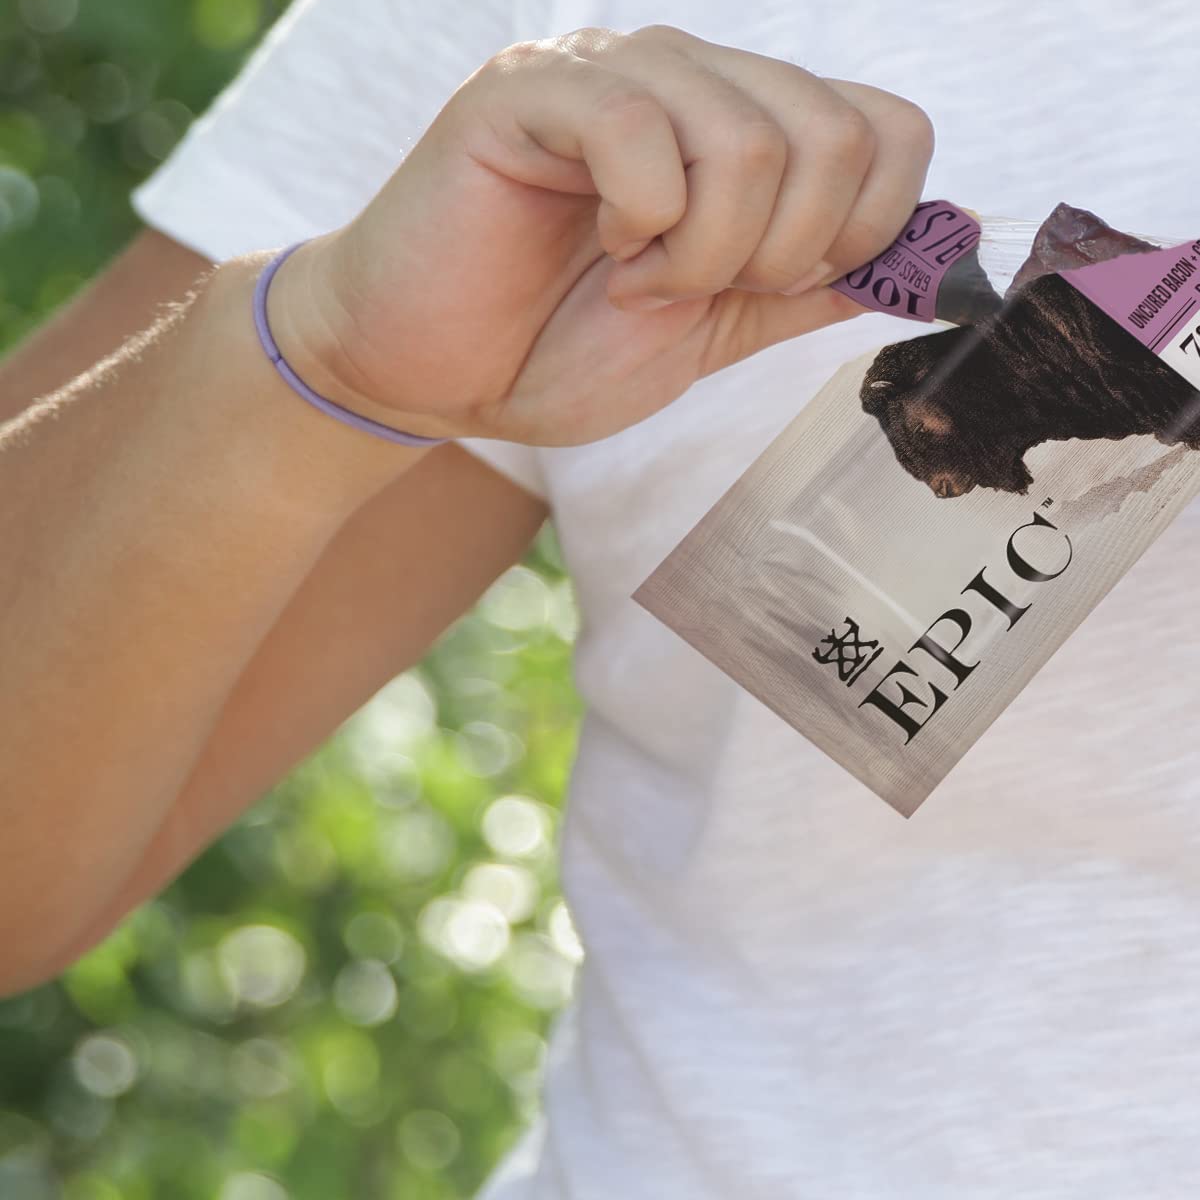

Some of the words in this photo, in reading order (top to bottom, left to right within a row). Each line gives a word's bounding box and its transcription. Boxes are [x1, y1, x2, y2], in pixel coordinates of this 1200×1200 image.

[882, 250, 902, 271] FED
[899, 261, 932, 292] GRASS
[1127, 284, 1172, 329] UNCURED
[1161, 257, 1197, 293] BACON
[857, 511, 1072, 746] EPIC
